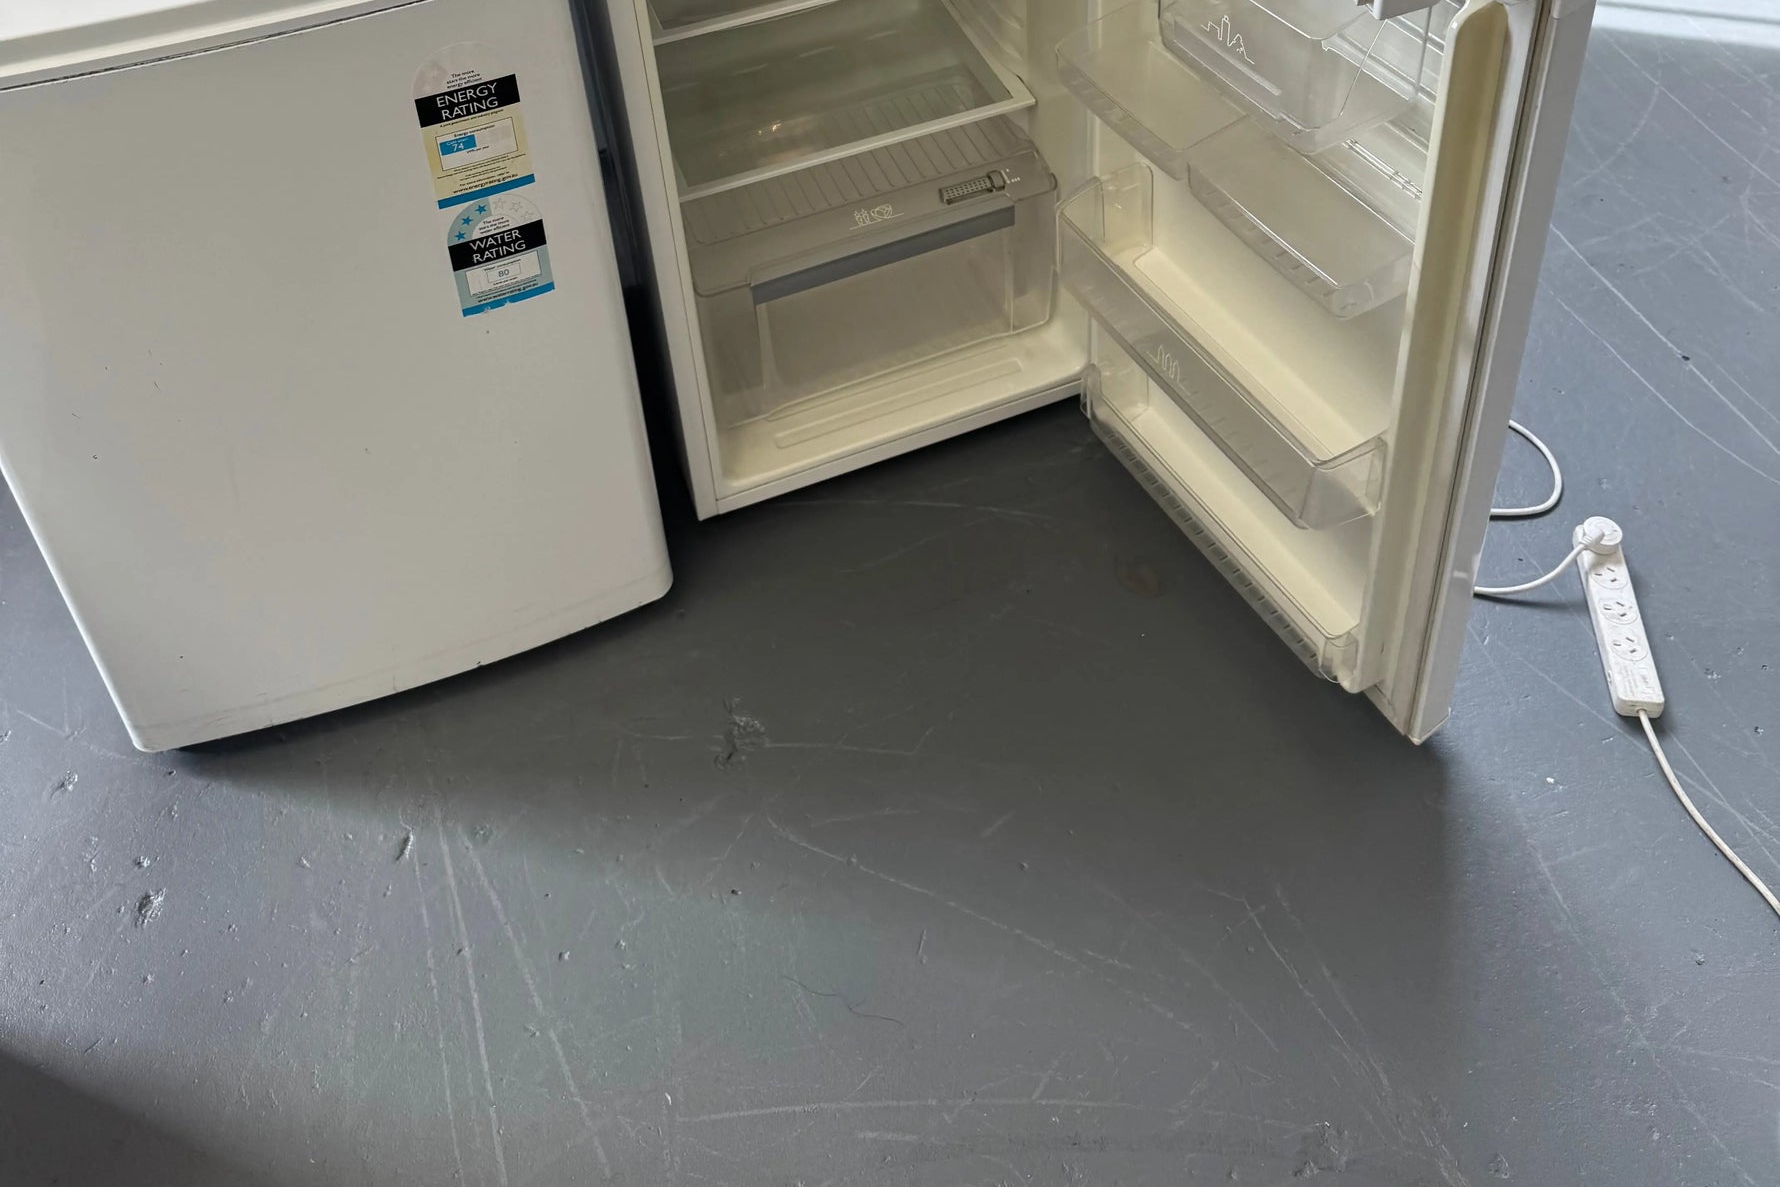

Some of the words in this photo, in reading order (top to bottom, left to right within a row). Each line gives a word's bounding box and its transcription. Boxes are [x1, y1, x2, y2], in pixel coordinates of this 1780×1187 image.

[436, 82, 498, 108] ENERGY
[441, 96, 499, 120] RATING
[452, 143, 465, 152] 74
[469, 229, 522, 251] WATER
[472, 240, 526, 264] RATING
[498, 269, 510, 277] 80
